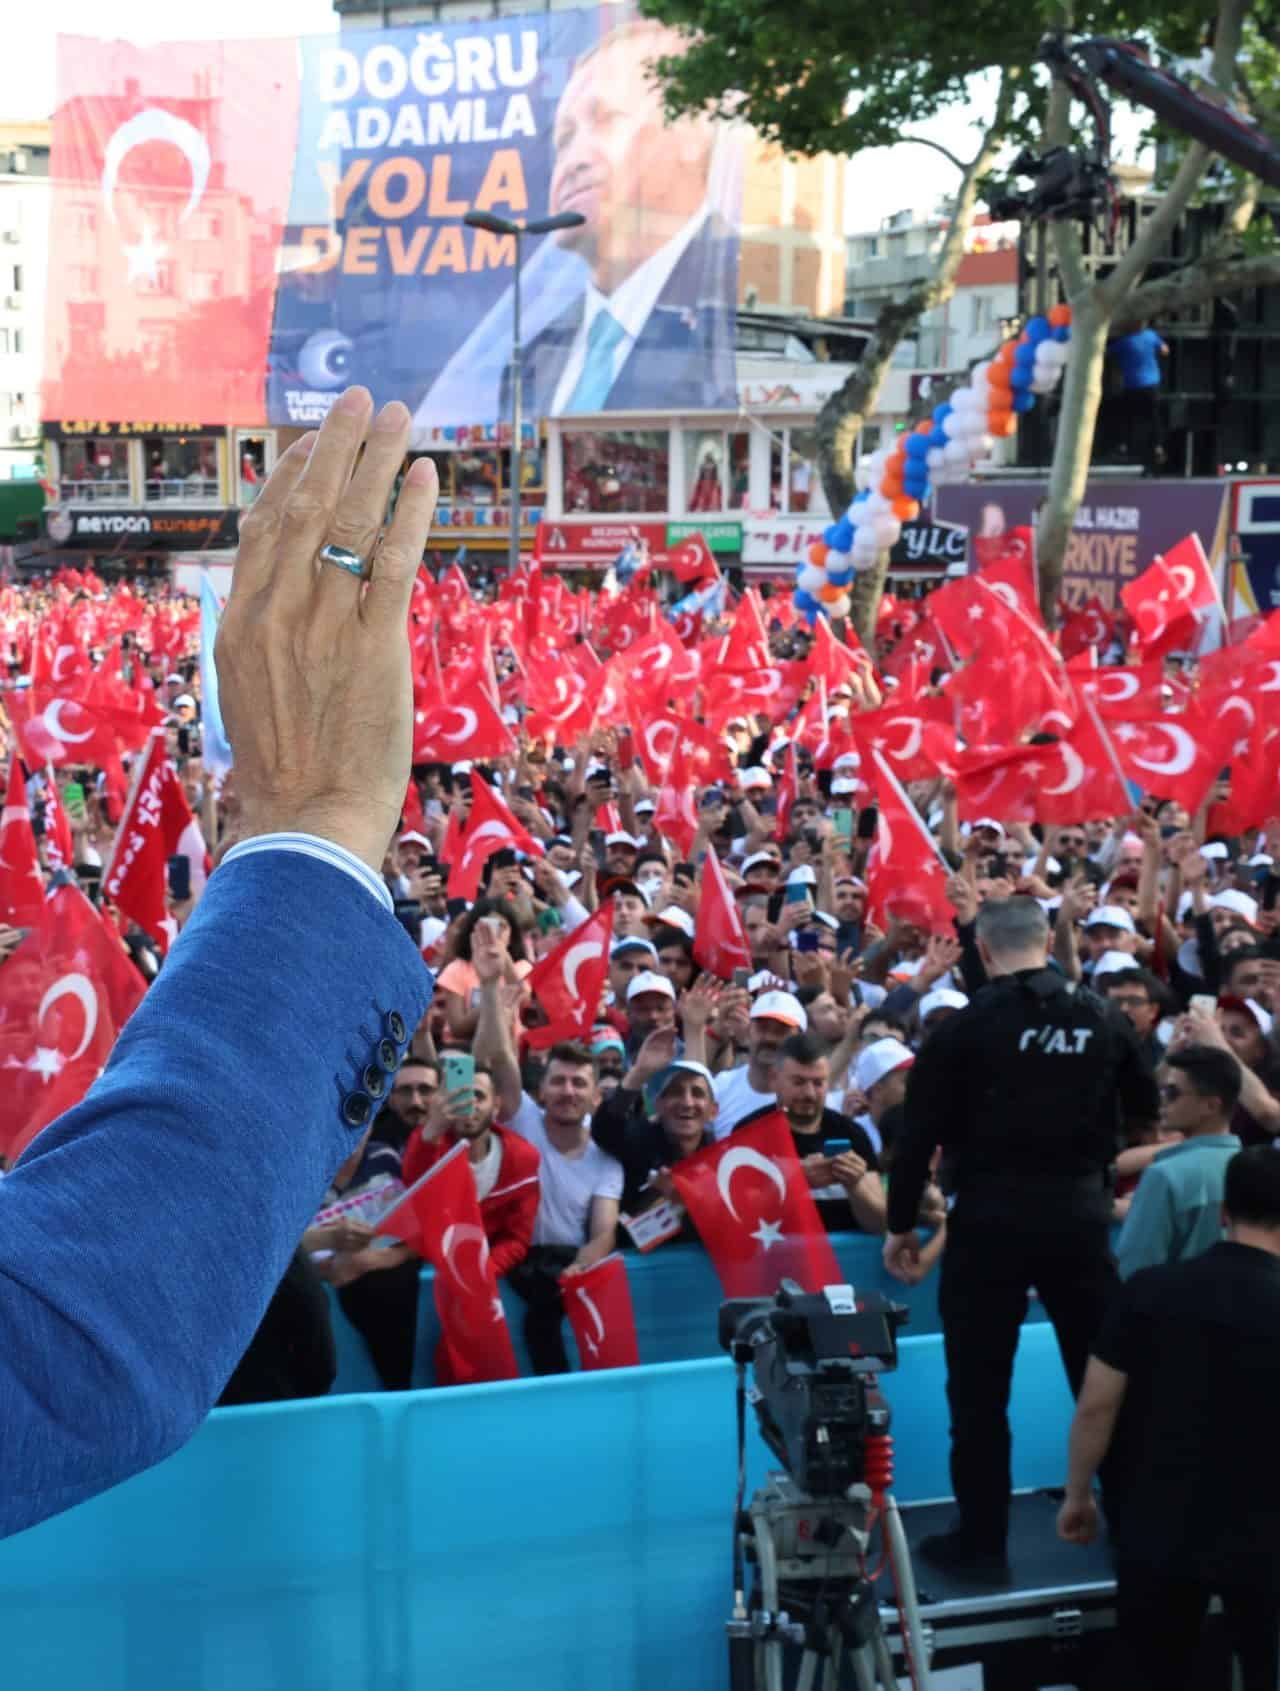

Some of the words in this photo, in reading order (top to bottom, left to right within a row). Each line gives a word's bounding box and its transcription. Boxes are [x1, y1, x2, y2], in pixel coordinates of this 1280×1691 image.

[318, 30, 539, 103] DOĞRU
[318, 93, 537, 150] ADAMLA
[316, 148, 529, 221] YOLA
[295, 218, 527, 276] DEVAM
